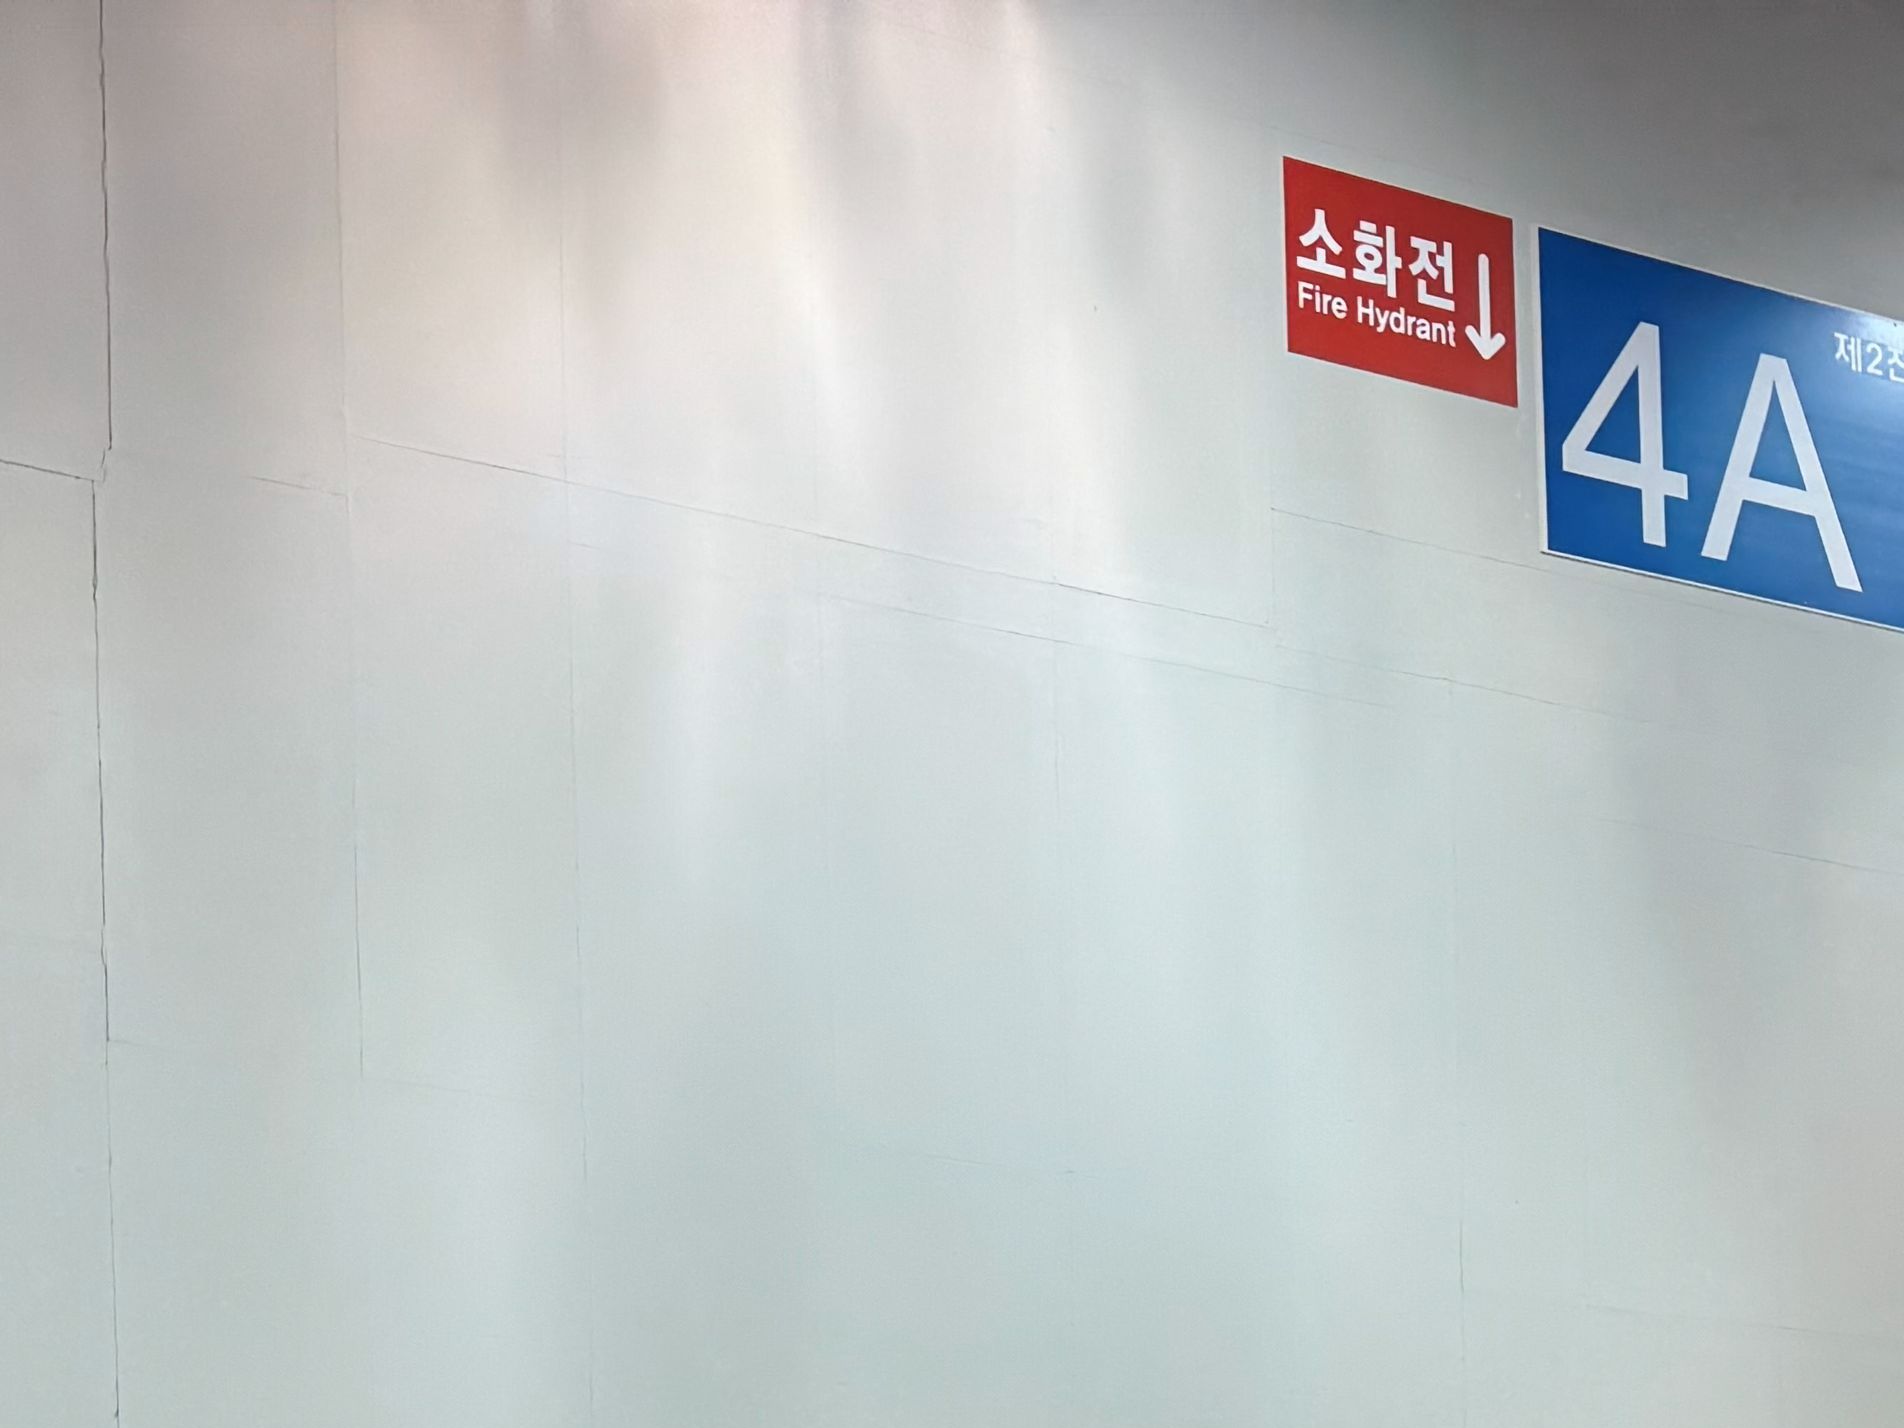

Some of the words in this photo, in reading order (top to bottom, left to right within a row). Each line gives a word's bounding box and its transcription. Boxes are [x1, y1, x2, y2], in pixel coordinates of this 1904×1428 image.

[1296, 208, 1456, 312] 소화전
[1297, 280, 1348, 320] Fire
[1356, 295, 1457, 348] Hydrant
[1561, 321, 1863, 593] 4A
